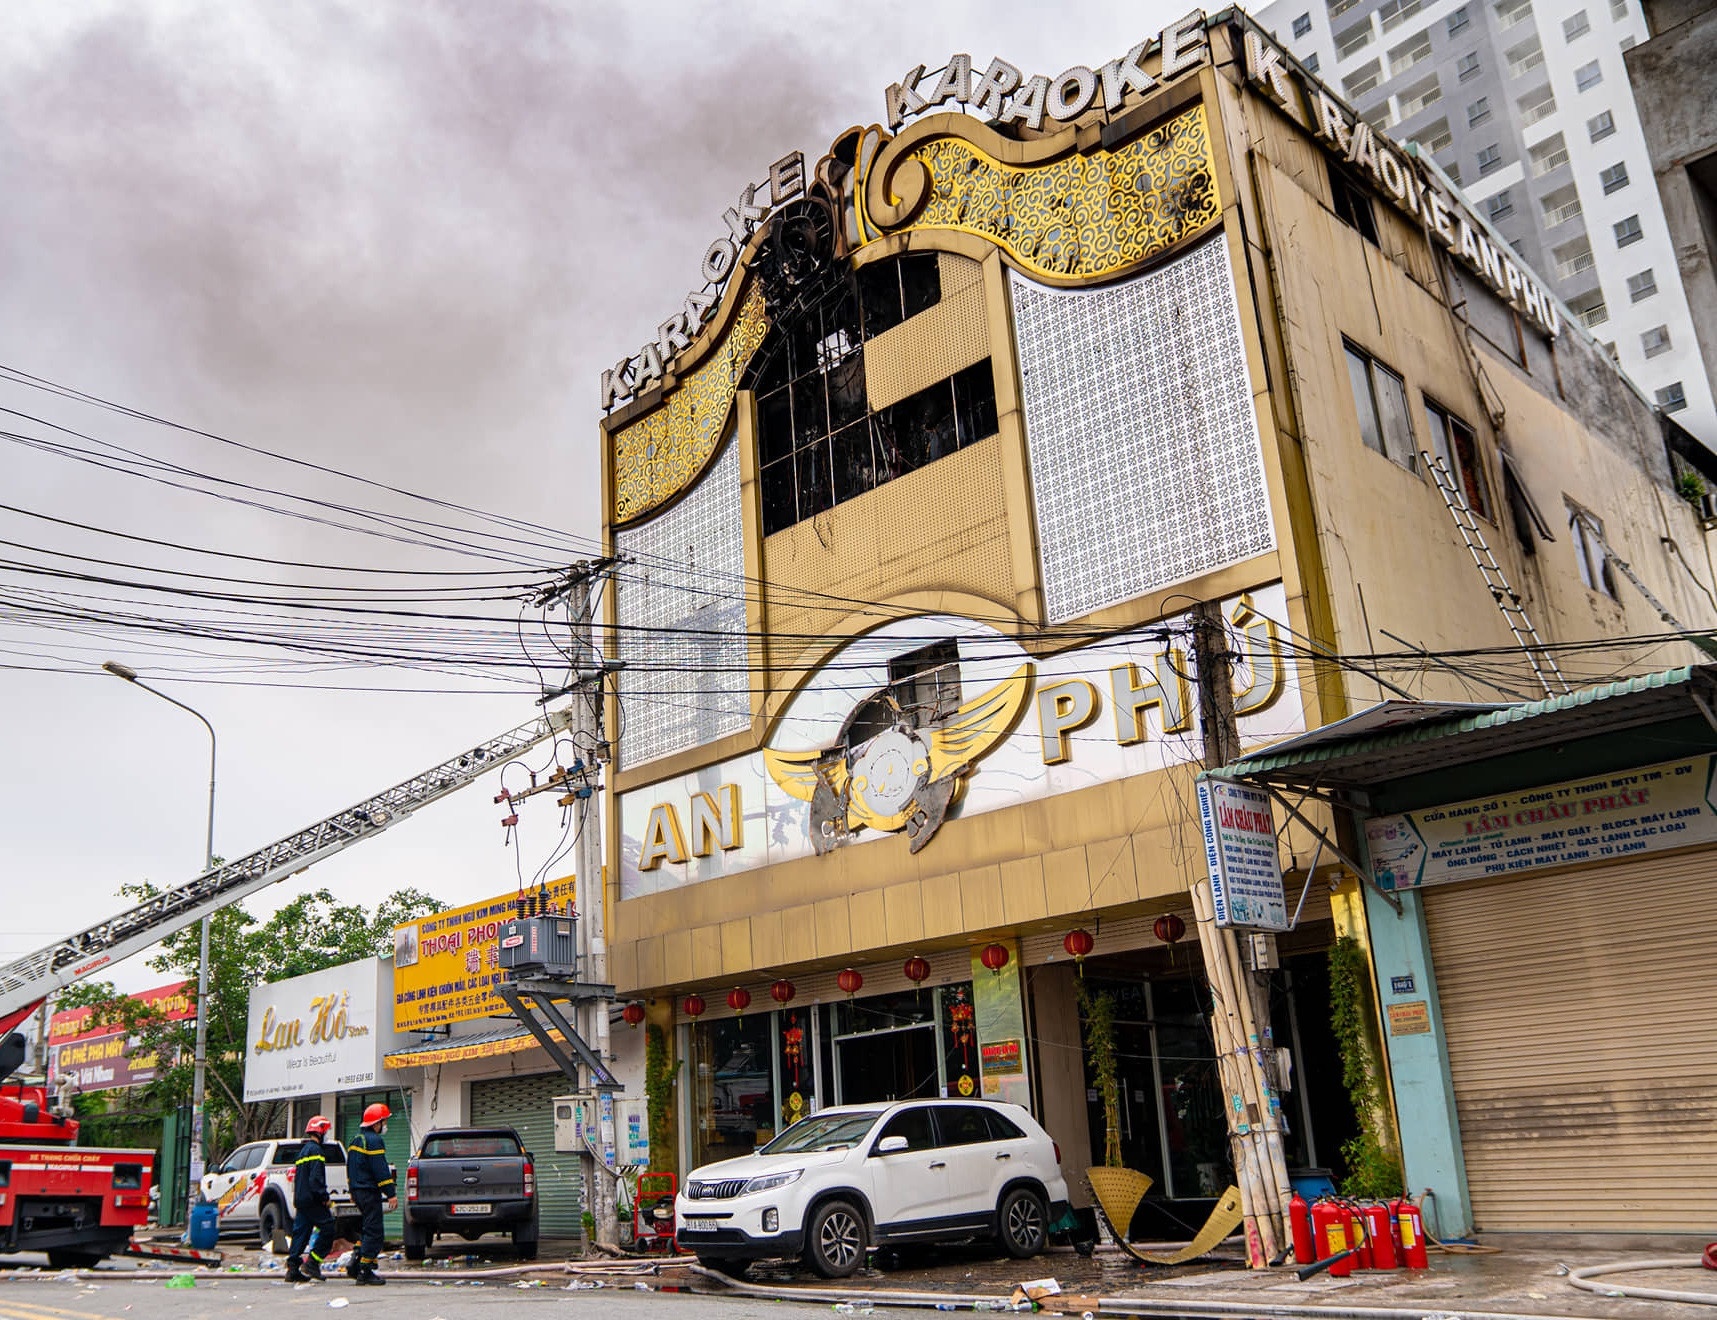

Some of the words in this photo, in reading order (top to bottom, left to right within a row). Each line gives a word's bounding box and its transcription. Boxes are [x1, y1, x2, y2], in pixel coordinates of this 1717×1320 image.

[884, 7, 1207, 132] KARAOKE
[601, 150, 806, 409] KARAOKE
[638, 784, 744, 871] AN
[1036, 592, 1286, 766] PHÚ
[1199, 786, 1212, 818] NGHIỆP
[1520, 790, 1554, 806] CÔNG
[1557, 787, 1571, 799] TY
[1573, 781, 1608, 795] TNHH
[1203, 819, 1215, 846] CÔNG
[1431, 848, 1453, 860] MÁY
[1455, 844, 1482, 857] LẠNH
[1490, 839, 1504, 851] TỦ
[1505, 836, 1533, 849] LẠNH
[1541, 828, 1565, 842] MÁY
[1601, 817, 1638, 832] BLOCK
[1640, 811, 1665, 825] MÁY
[1668, 806, 1701, 821] LẠNH
[1464, 813, 1514, 837] LÂM
[1515, 800, 1578, 827] CHÂU
[1506, 845, 1536, 859] CÁCH
[1536, 840, 1567, 855] NHIỆT
[1576, 836, 1599, 848] GAS
[1601, 830, 1632, 844] LẠNH
[1633, 825, 1658, 839] CÁC
[1660, 820, 1687, 835] LOẠI
[1508, 857, 1533, 871] KIỆN
[1535, 852, 1558, 866] MÁY
[1560, 849, 1590, 862] LẠNH
[1599, 843, 1613, 856] TỦ
[1616, 839, 1646, 854] LẠNH
[1207, 846, 1219, 868] ĐIỆN
[1212, 873, 1223, 899] LẠNH
[421, 920, 438, 935] CÔNG
[446, 914, 462, 928] TNHH
[1215, 898, 1226, 921] ĐIỆN
[74, 955, 111, 976] MAGIRUS
[254, 1005, 304, 1056] Lan
